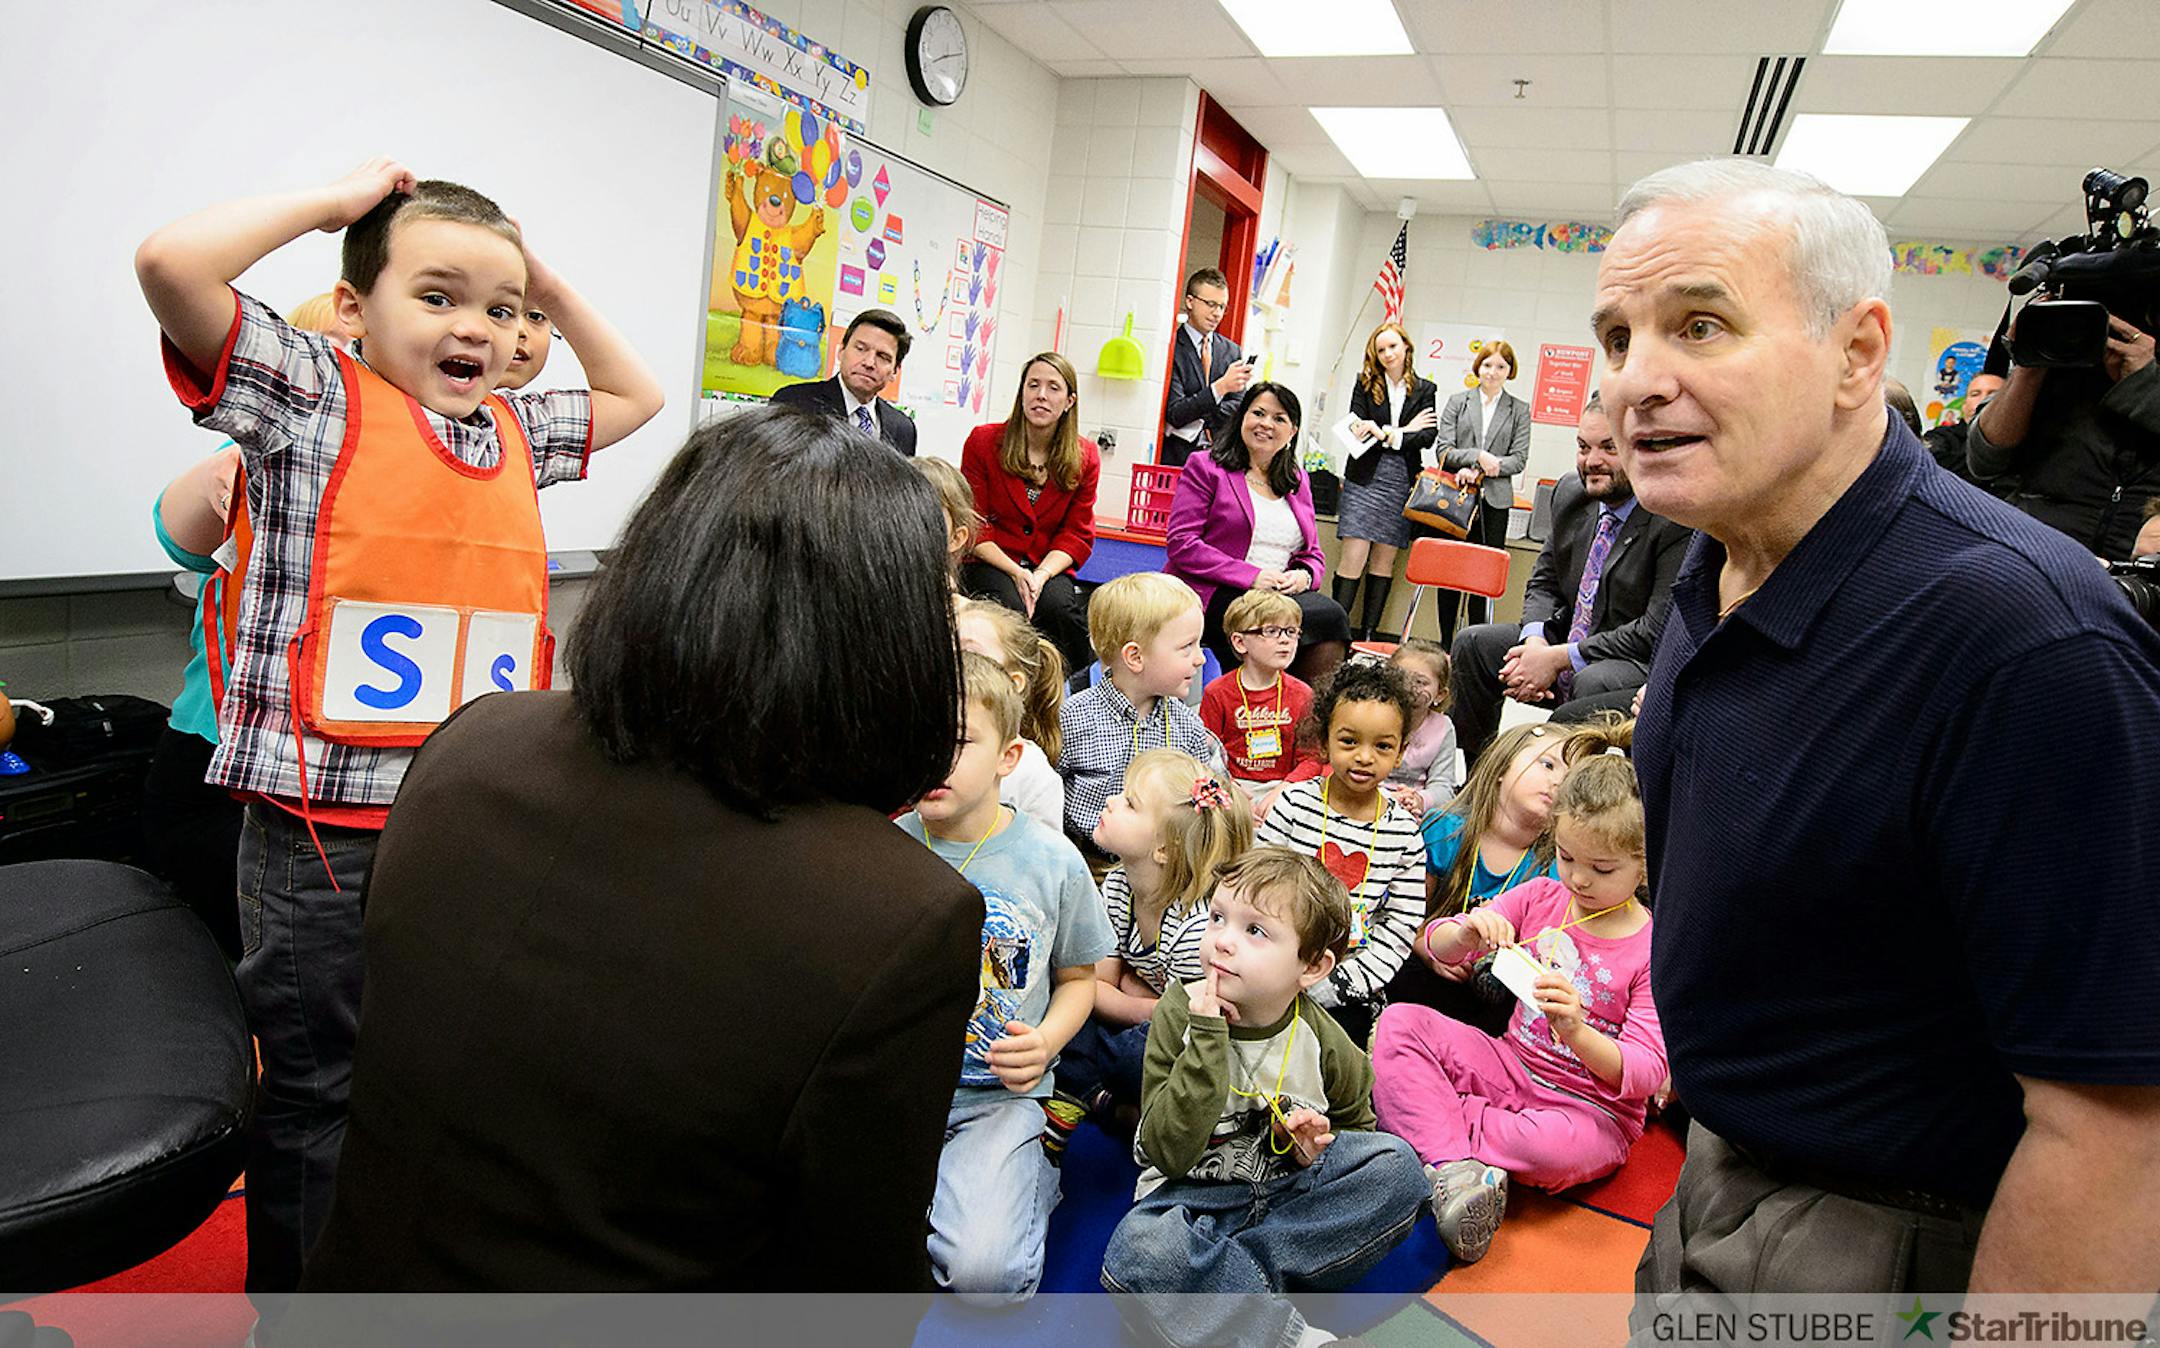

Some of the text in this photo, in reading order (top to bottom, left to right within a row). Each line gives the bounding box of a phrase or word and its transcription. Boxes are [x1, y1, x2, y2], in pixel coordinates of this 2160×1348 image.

[666, 0, 857, 106] Uu Vv Ww Xx Yy Zz
[1429, 338, 1444, 359] 2
[354, 614, 516, 710] S s
